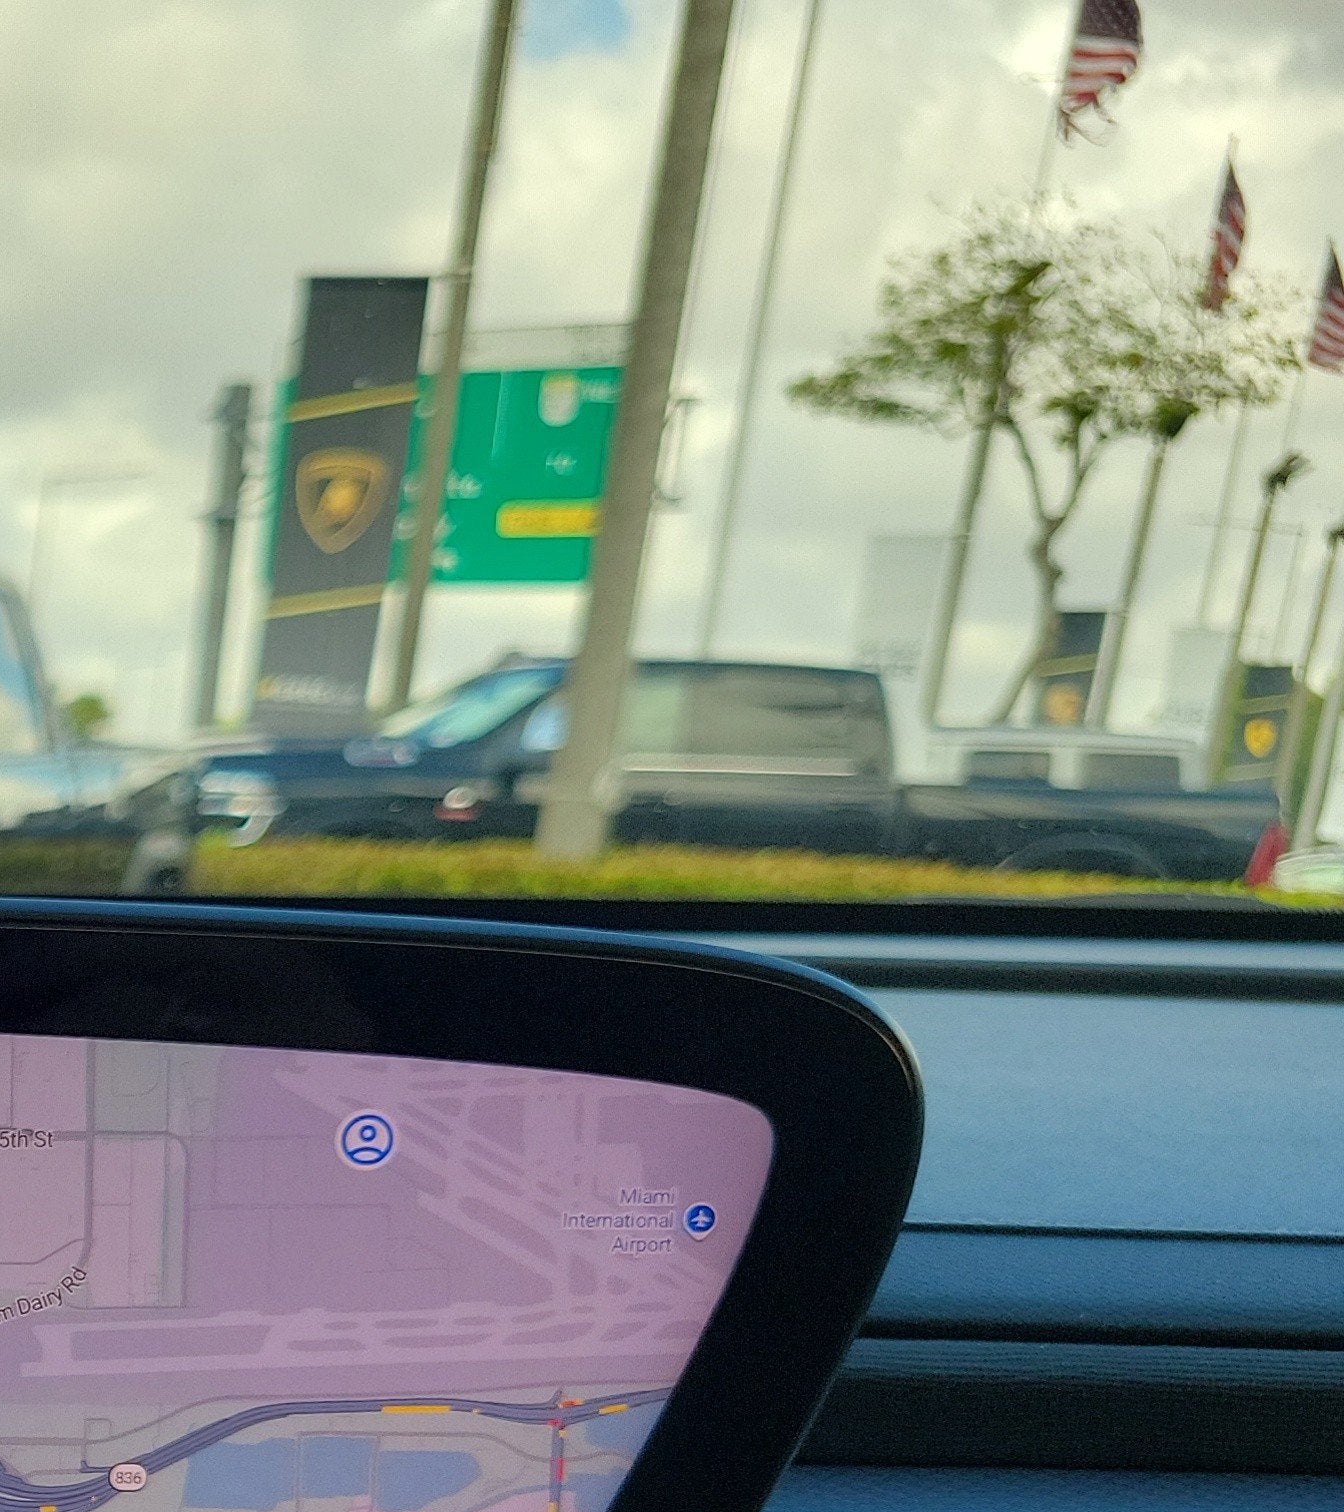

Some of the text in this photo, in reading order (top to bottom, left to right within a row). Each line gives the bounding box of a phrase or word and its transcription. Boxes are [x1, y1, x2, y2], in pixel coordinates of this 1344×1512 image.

[34, 1131, 54, 1148] St
[619, 1188, 675, 1204] Miami
[562, 1212, 673, 1229] International
[611, 1236, 672, 1257] Airport
[16, 1285, 63, 1317] Dairy
[61, 1267, 88, 1294] Rd
[115, 1471, 142, 1485] 836
